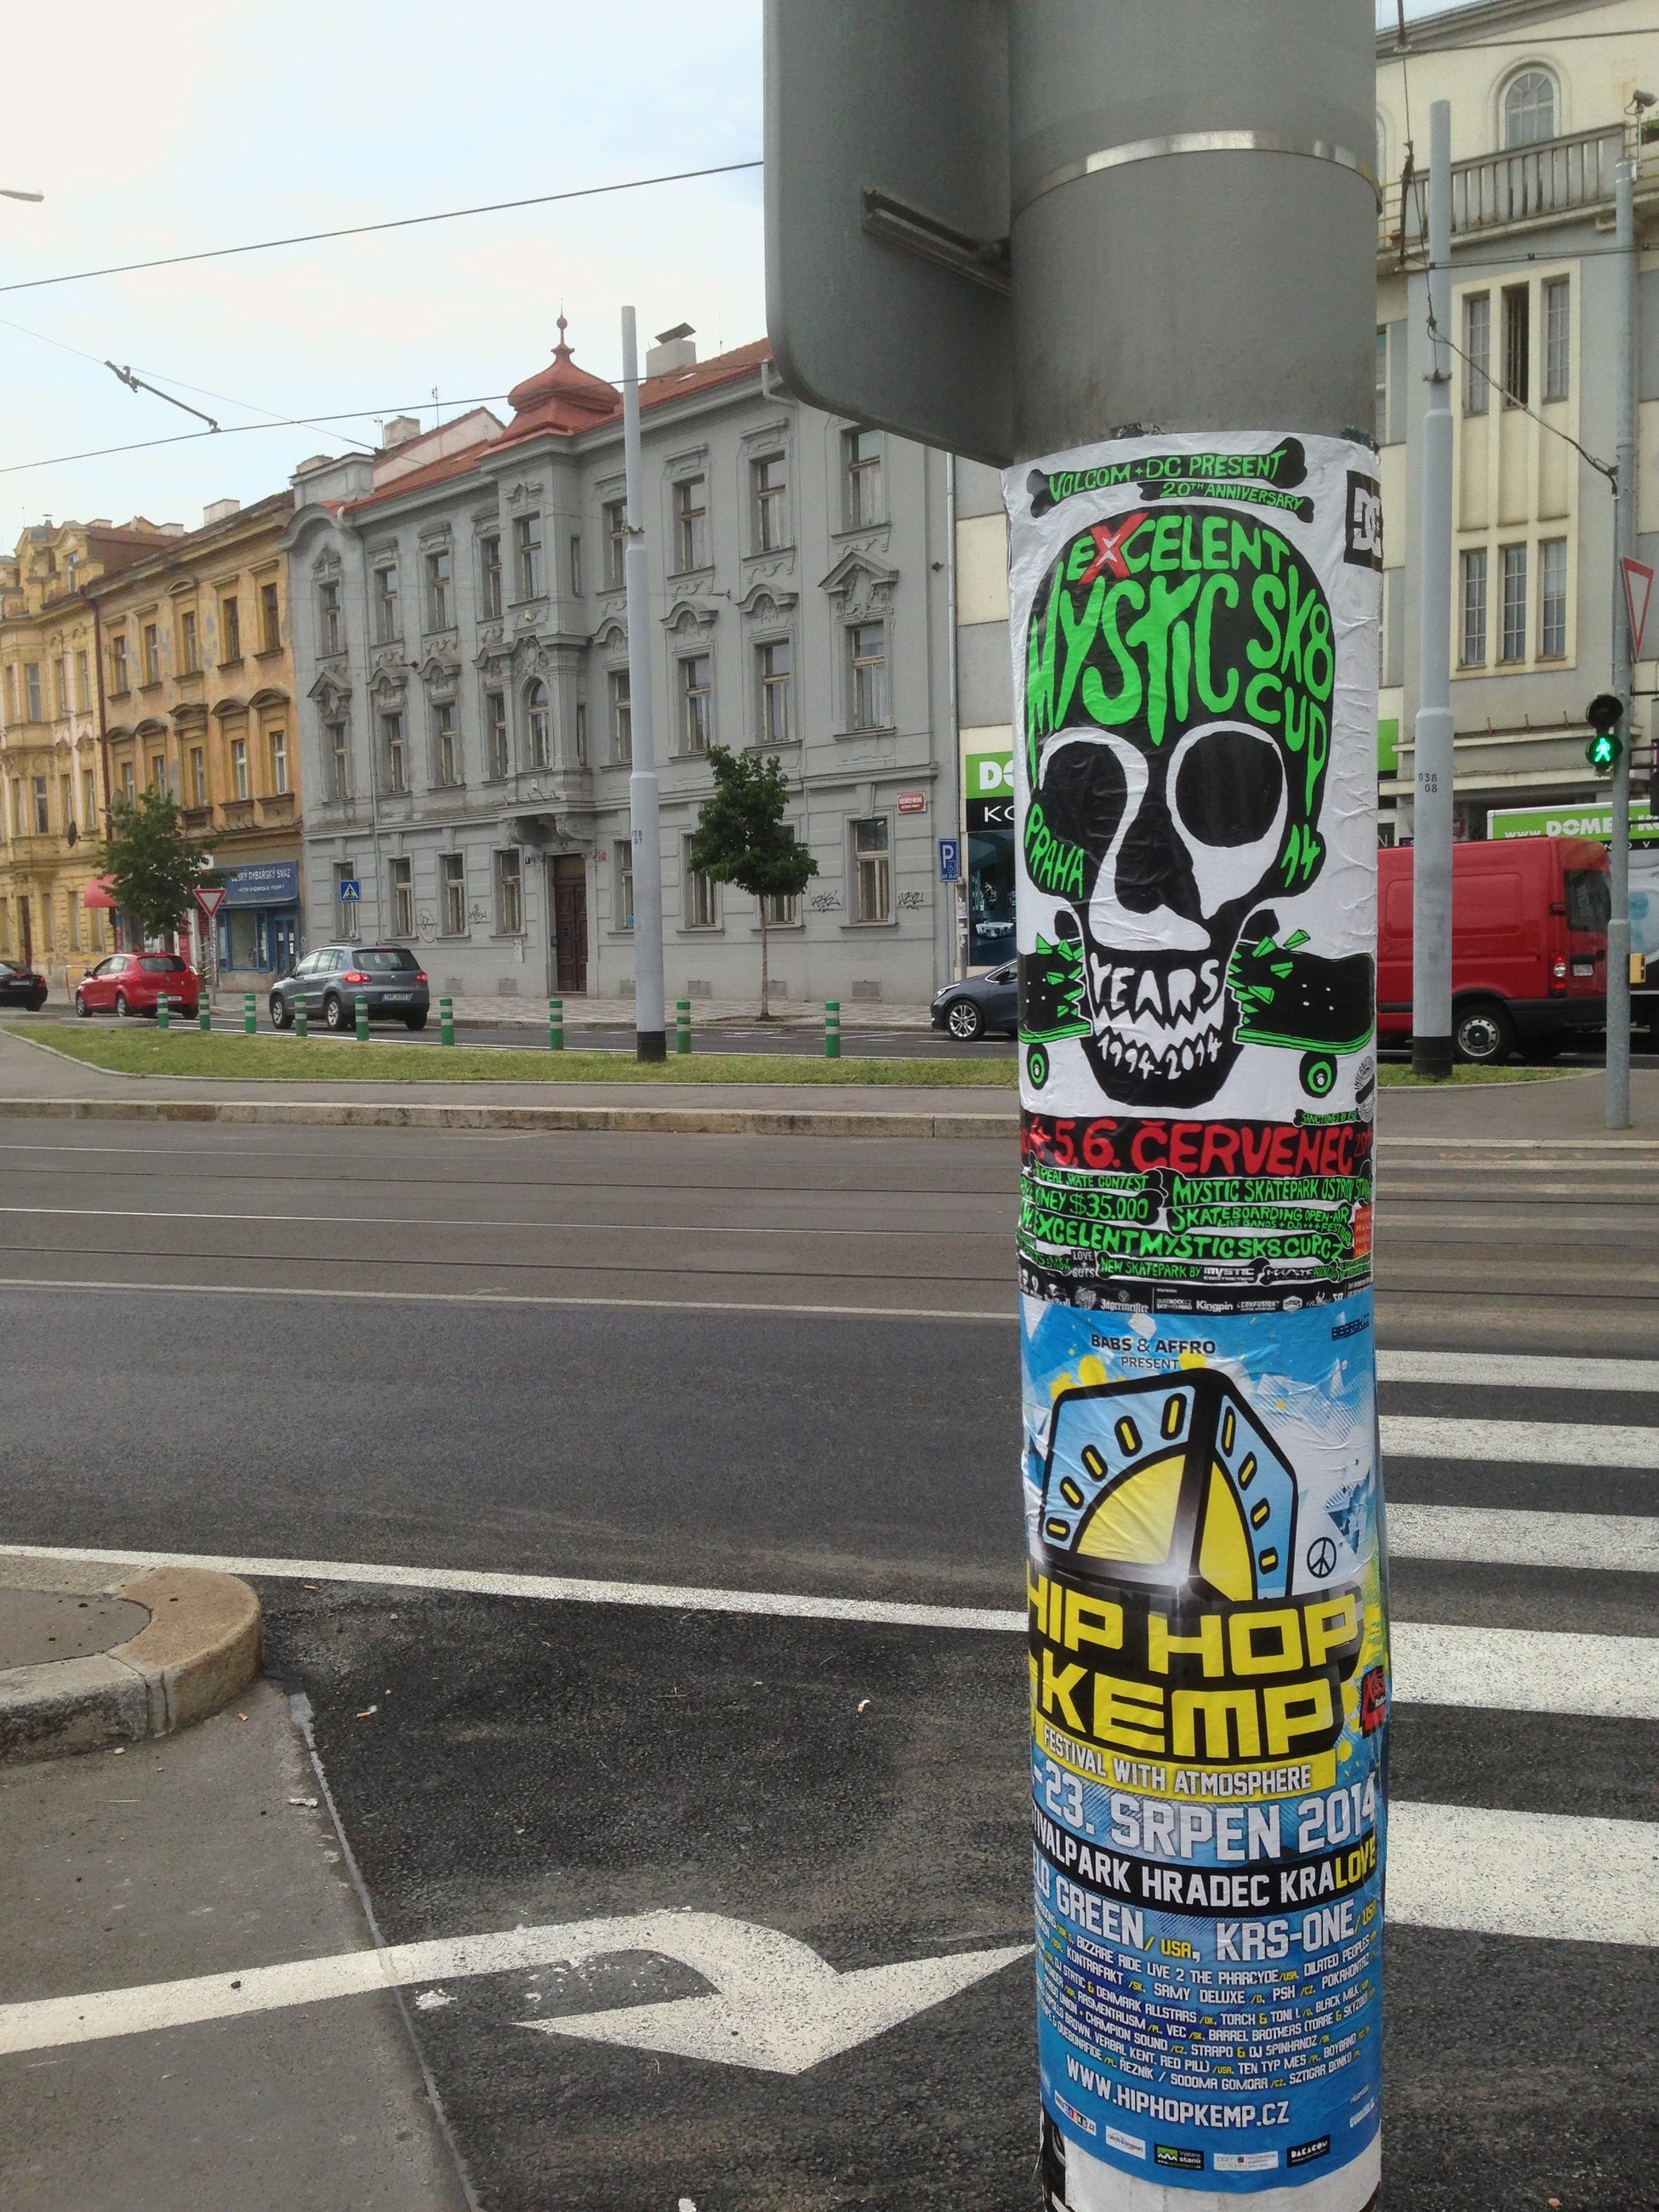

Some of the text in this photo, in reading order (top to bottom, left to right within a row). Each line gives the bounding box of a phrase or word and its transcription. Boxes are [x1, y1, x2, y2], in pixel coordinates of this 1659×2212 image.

[1049, 464, 1131, 503] VOLCOM
[1145, 456, 1182, 476] DC
[1189, 449, 1287, 480] PRESENT
[1205, 482, 1303, 511] ANNIVERSARY
[1066, 511, 1291, 585] EXCELENT
[1027, 562, 1333, 788] MYSTIC SK8
[1418, 772, 1438, 783] 038
[1424, 784, 1438, 793] 08
[1025, 803, 1320, 898] PRAHA 14
[1090, 953, 1221, 1030] YEARS
[1097, 1031, 1223, 1080] 1994-2014
[1132, 1120, 1354, 1177] ČERVENEC
[1066, 1172, 1095, 1188] SKATE
[1097, 1175, 1149, 1192] CONTEST
[1172, 1176, 1240, 1206] MYSTIC
[1245, 1178, 1320, 1201] SKATEPARK
[1069, 1193, 1149, 1221] $35.000
[1172, 1206, 1349, 1232] SKATEBOARDING OPEN-AIR
[1217, 1219, 1240, 1228] LIVE
[1243, 1218, 1277, 1229] BANDS
[1321, 1223, 1353, 1246] FESTIVAL
[1072, 1267, 1096, 1279] GUTS
[1073, 1251, 1094, 1261] LOVE
[1100, 1258, 1123, 1274] NEW
[1125, 1262, 1188, 1278] SKATEPARK
[1189, 1266, 1203, 1277] BY
[1196, 1300, 1234, 1313] Kingpin
[1091, 1334, 1216, 1354] BABS & AFFRO
[1120, 1356, 1179, 1370] PRESENT
[1027, 1571, 1360, 1678] HIP HOP
[1042, 1648, 1334, 1759] KEMP
[1043, 1723, 1313, 1797] FESTIVAL WITH ATMOSPHERE
[1110, 1793, 1281, 1861] SRPEN
[1298, 1771, 1376, 1854] 2014
[1143, 1865, 1270, 1907] HRADEC
[1280, 1834, 1376, 1904] KRALOVE
[1067, 1946, 1124, 1985] KONTRAFAKT
[1154, 1982, 1191, 2001] SAMY
[1200, 1989, 1246, 2004] DELUXE
[1273, 1986, 1296, 2002] PSH
[1077, 1935, 1114, 1964] BIZZARE
[1118, 1954, 1143, 1973] RIDE
[1147, 1962, 1171, 1980] LIVE
[1176, 1968, 1184, 1982] 2
[1190, 1970, 1212, 1985] THE
[1303, 1953, 1339, 1977] DILATED
[1063, 1965, 1086, 1989] STATIC
[1096, 1987, 1142, 2013] DENMARK
[1145, 2004, 1197, 2024] ALLSTARS
[1220, 2014, 1256, 2026] TORCH
[1258, 2013, 1268, 2025] &
[1270, 2009, 1293, 2022] TONI
[1315, 1993, 1341, 2014] BLACK
[1085, 2010, 1132, 2042] CHAMPION
[1133, 2032, 1168, 2051] SOUND
[1191, 2044, 1234, 2058] STRAPO
[1237, 2047, 1246, 2059] &
[1249, 2046, 1263, 2058] DJ
[1265, 2034, 1318, 2055] SPINHANDZ
[1166, 2023, 1187, 2038] VEC
[1209, 2029, 1249, 2042] BARREL
[1251, 2023, 1302, 2042] BROTHERS
[1335, 2010, 1342, 2022] &
[1094, 2031, 1127, 2056] VERBAL
[1160, 2055, 1182, 2070] RED
[1238, 2062, 1257, 2075] TEN
[1261, 2060, 1281, 2073] TYP
[1284, 2054, 1307, 2070] MES
[1324, 2032, 1357, 2059] BOYBAND
[1120, 2056, 1154, 2080] ŘEZNÍK
[1171, 2072, 1218, 2089] SODOMA
[1222, 2078, 1268, 2091] GOMORA
[1328, 2052, 1352, 2073] BONKO
[1066, 2055, 1291, 2128] WWW.HIPHOPKEMP.CZ
